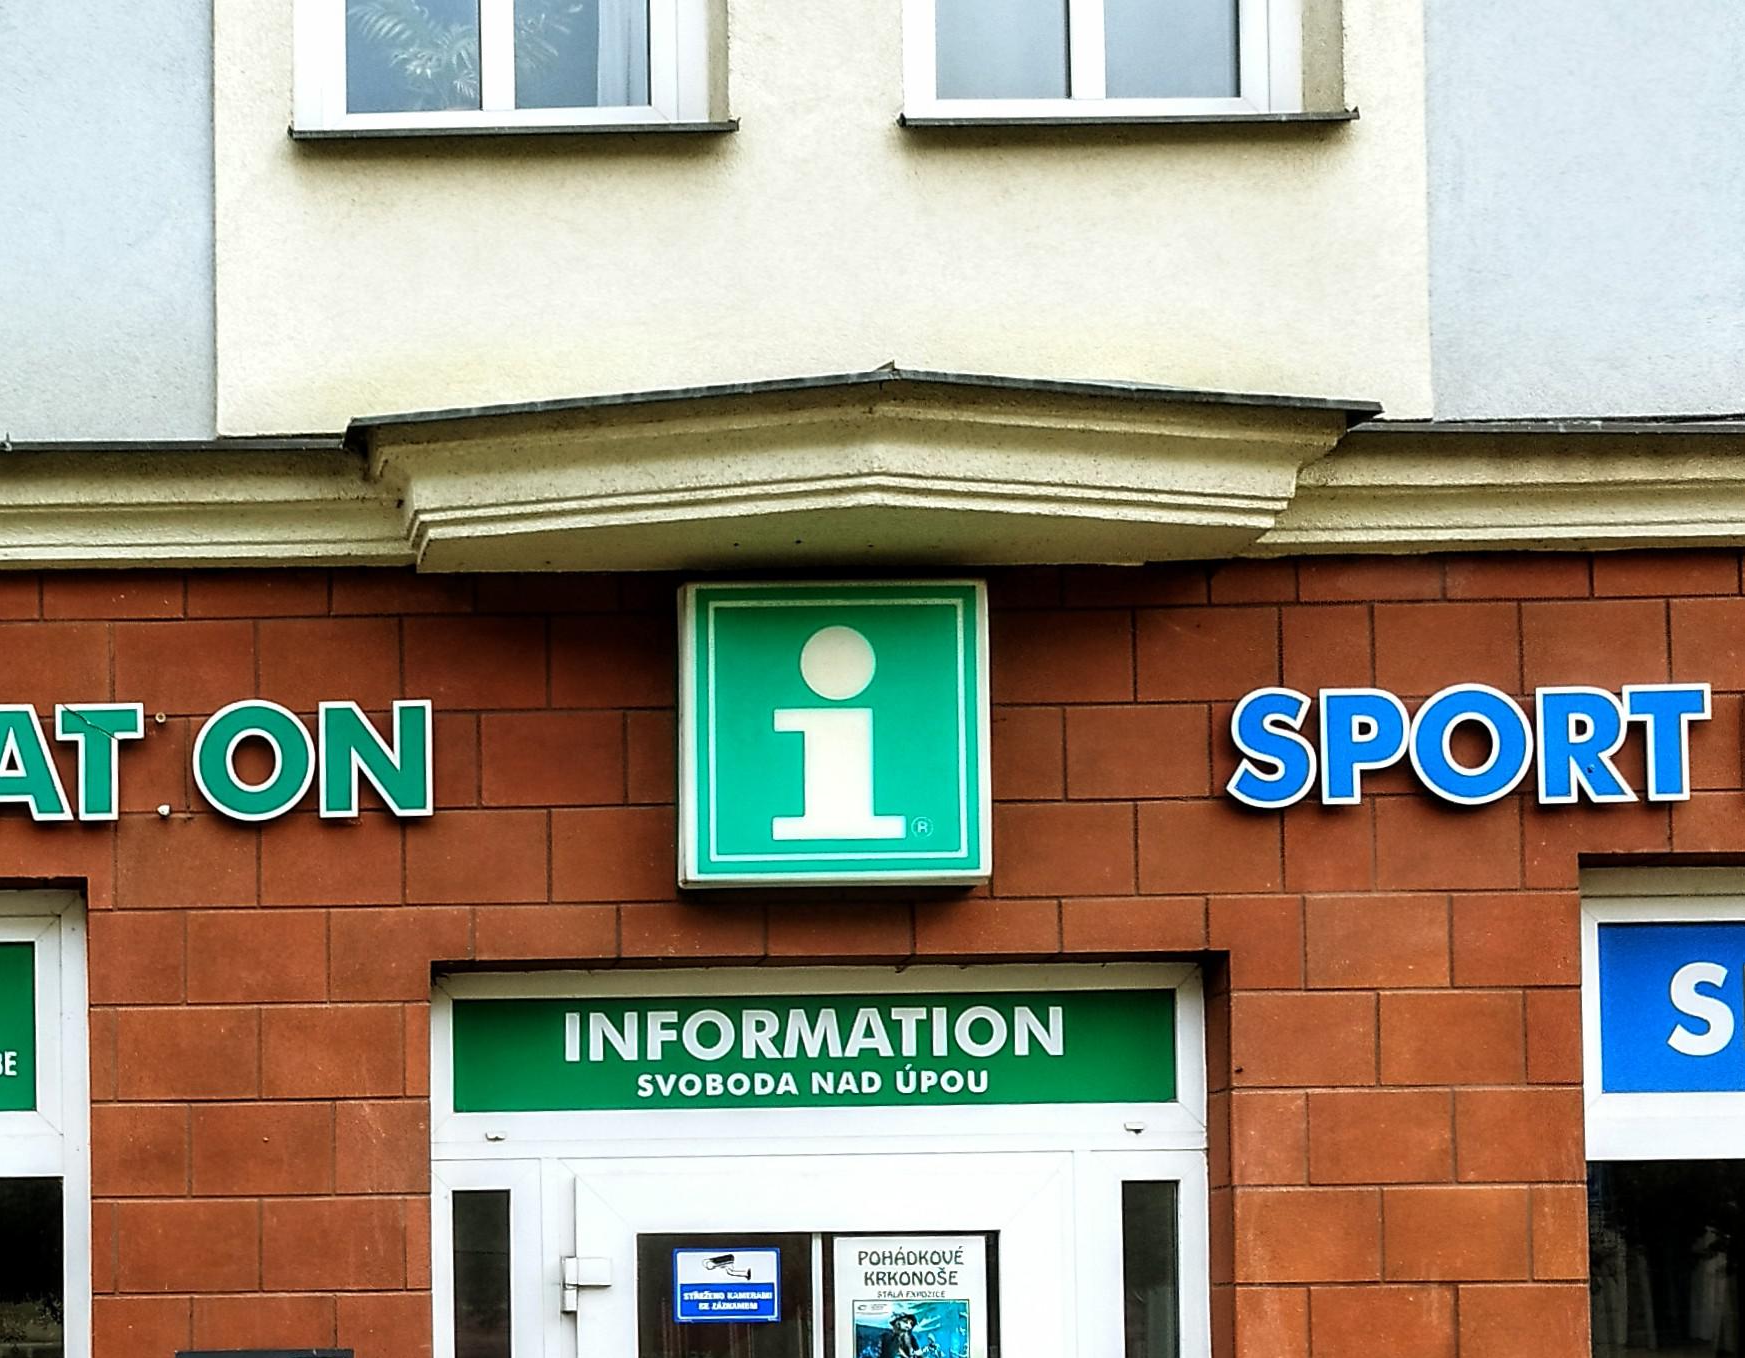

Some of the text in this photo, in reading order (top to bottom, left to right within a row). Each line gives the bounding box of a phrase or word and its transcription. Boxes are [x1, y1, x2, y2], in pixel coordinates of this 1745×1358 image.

[1226, 683, 1712, 808] SPORT
[564, 1005, 1066, 1063] INFORMATION
[636, 1063, 990, 1097] SVOBODA NAD ÚPOU
[857, 1246, 964, 1266] POHÁDKOVÉ
[863, 1267, 959, 1287] KRKONOŠE
